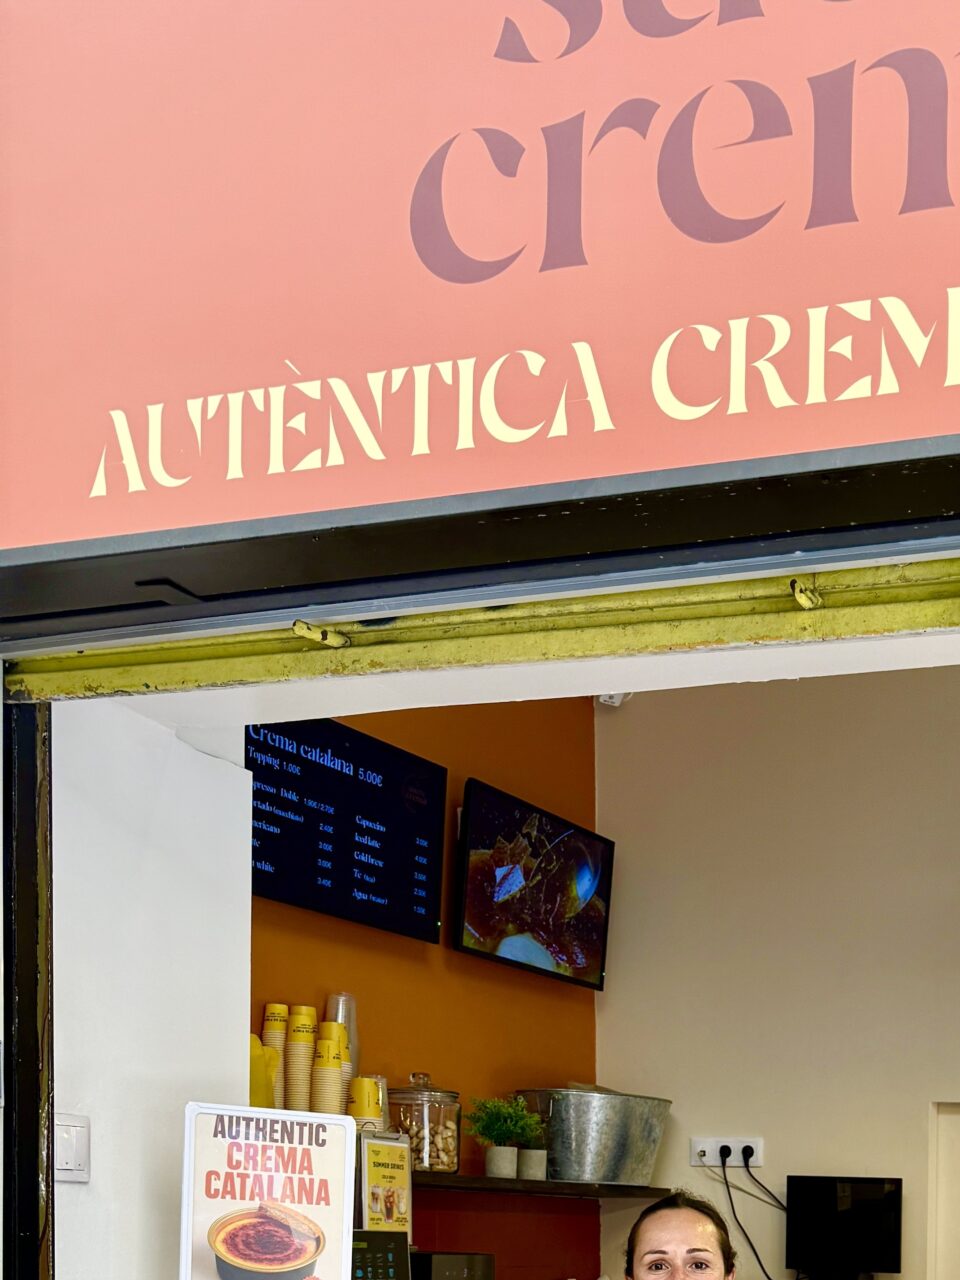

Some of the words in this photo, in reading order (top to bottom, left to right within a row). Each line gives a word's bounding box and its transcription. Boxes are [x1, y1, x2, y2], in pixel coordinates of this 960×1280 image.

[90, 360, 614, 497] AUTÈNTICA
[248, 745, 280, 770] Topping
[249, 724, 297, 754] Crema
[300, 744, 354, 776] catalana
[358, 768, 383, 787] 5.00€
[213, 1115, 327, 1147] AUTHENTIC
[226, 1141, 313, 1175] CREMA
[205, 1170, 331, 1206] CATALANA
